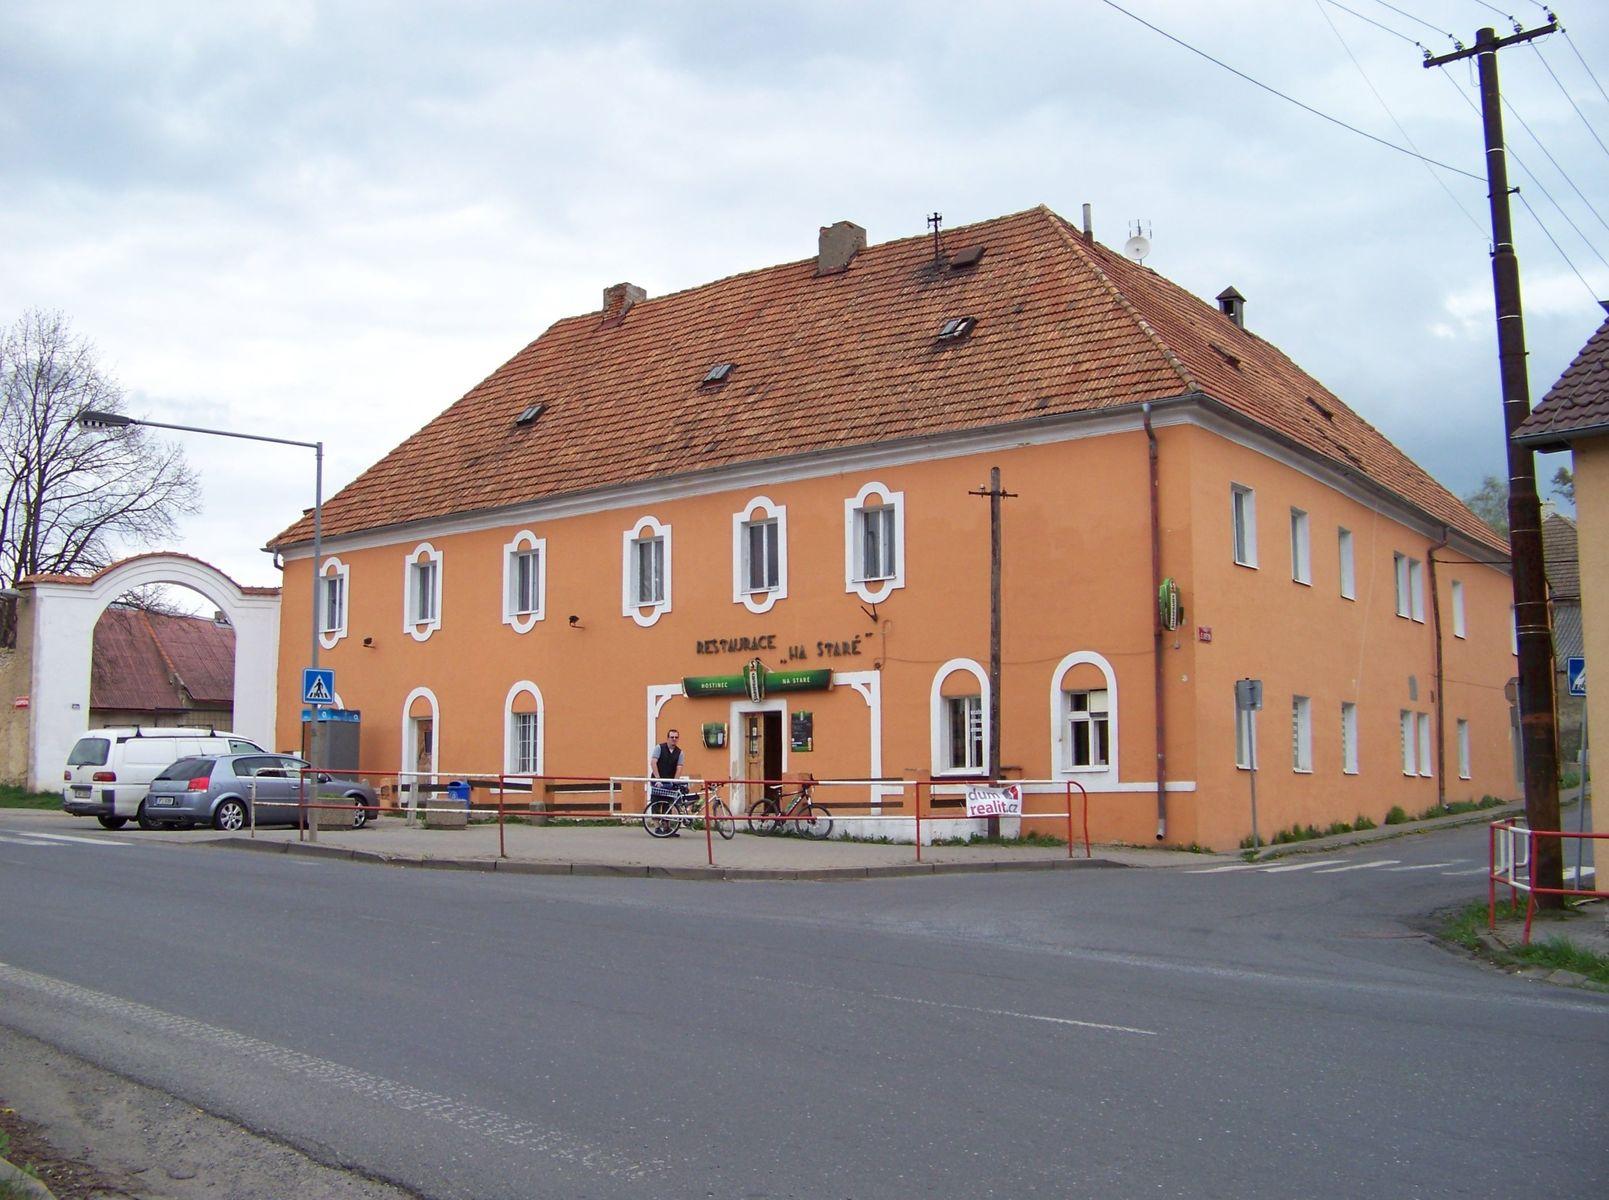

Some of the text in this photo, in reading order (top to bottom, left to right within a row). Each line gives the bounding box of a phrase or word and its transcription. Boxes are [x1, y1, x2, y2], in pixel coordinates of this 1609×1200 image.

[696, 635, 777, 655] RESTAURACE
[968, 788, 1000, 801] dum
[970, 800, 1018, 816] realit.cz
